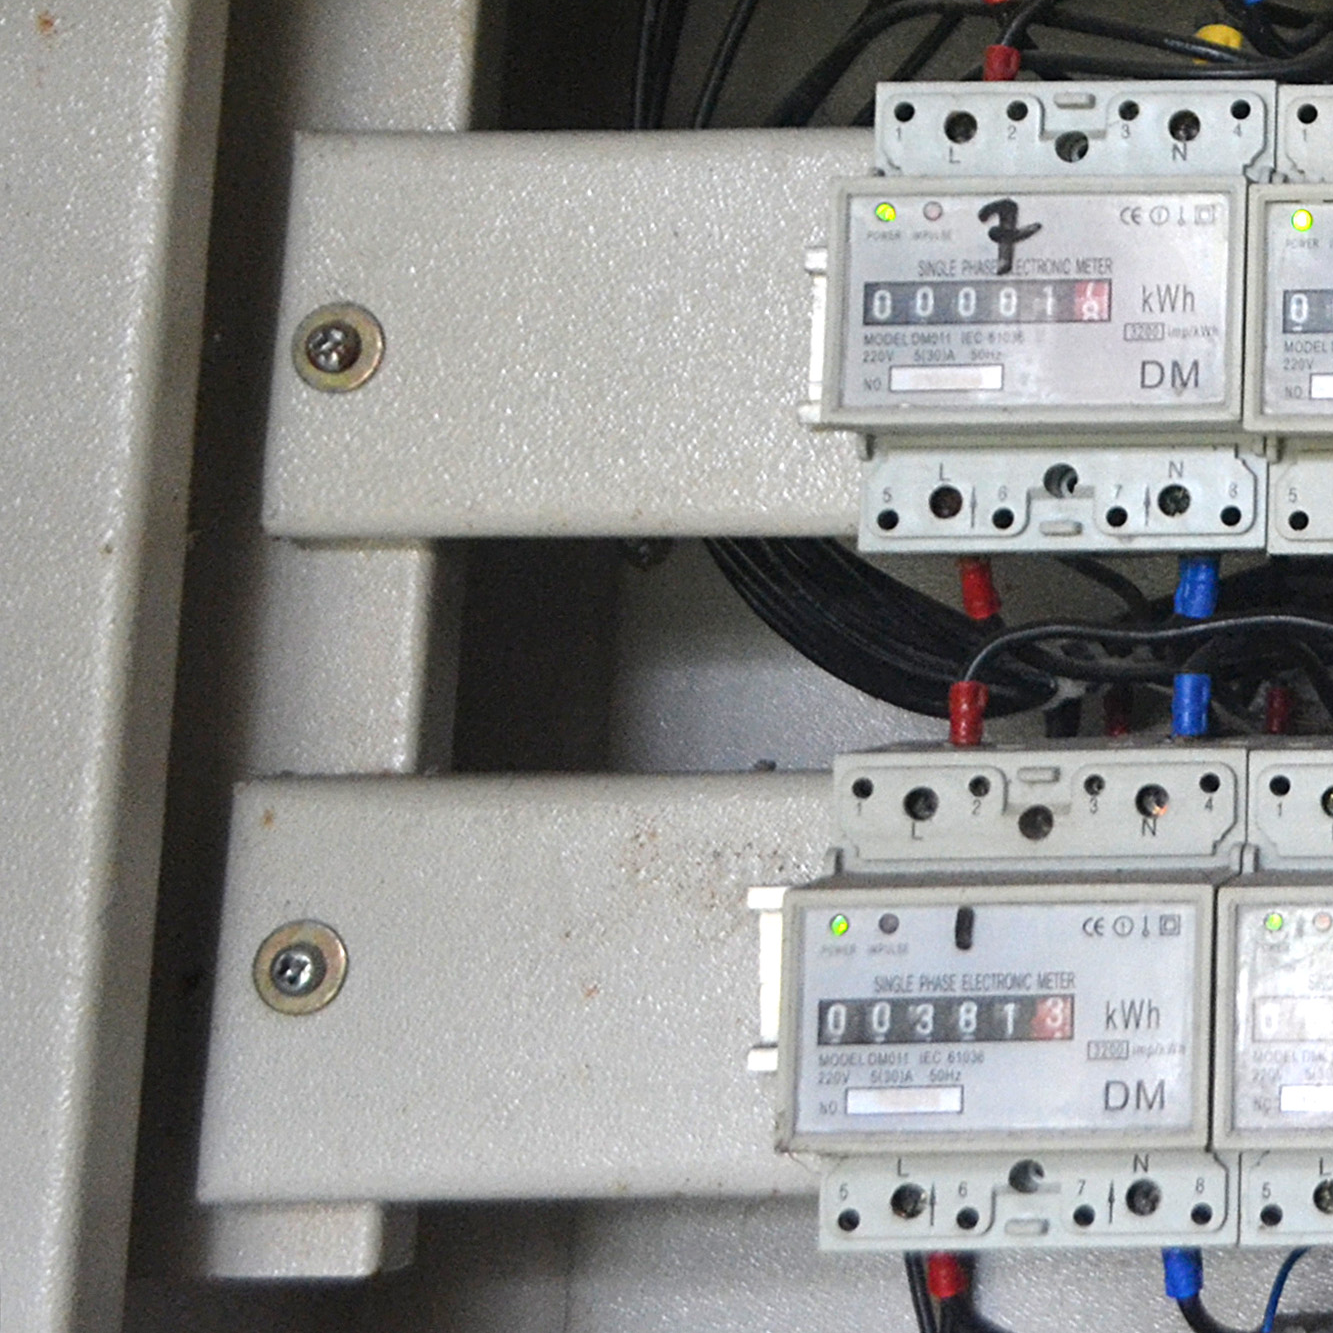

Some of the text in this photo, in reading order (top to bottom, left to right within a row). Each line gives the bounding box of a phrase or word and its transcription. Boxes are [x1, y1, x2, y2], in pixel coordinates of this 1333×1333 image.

[976, 199, 1042, 275] 7
[1141, 283, 1196, 313] kWh
[1139, 359, 1200, 389] DM
[954, 905, 975, 950] 1
[823, 998, 1161, 1041] 003813 kWh
[1103, 1079, 1165, 1111] DM
